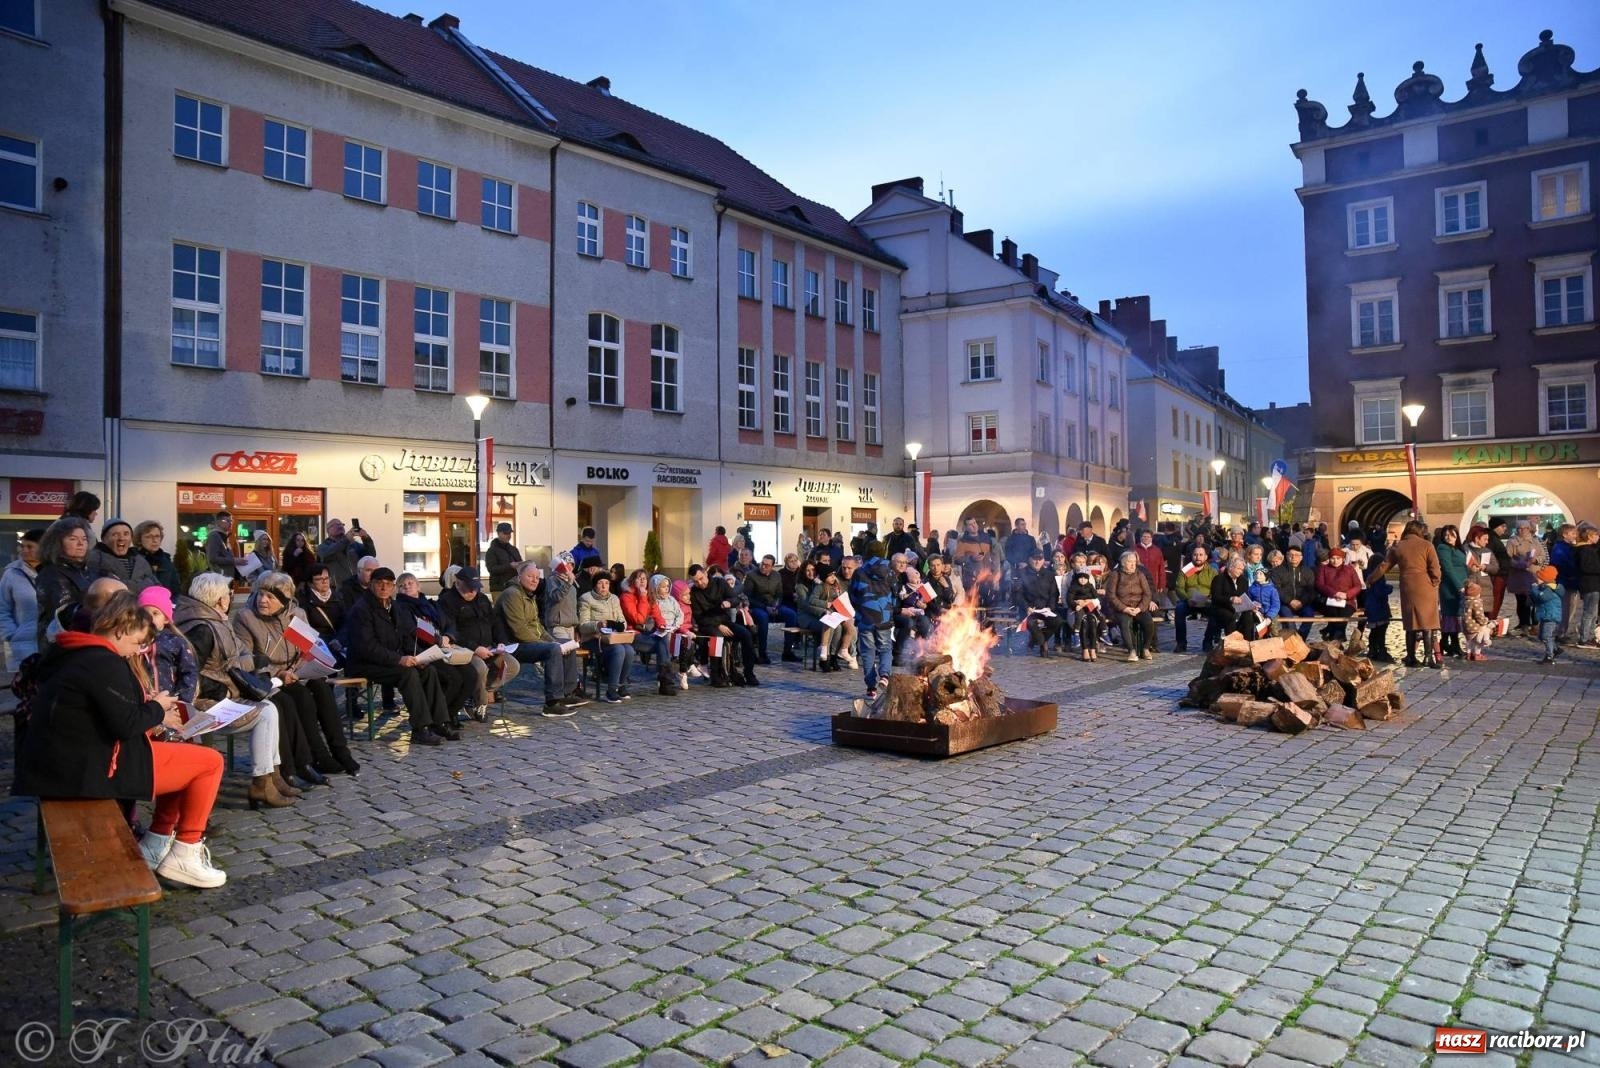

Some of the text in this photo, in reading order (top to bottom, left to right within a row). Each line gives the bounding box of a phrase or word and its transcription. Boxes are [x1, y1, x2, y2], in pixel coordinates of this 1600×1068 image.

[392, 448, 497, 475] JUBILE
[1451, 441, 1581, 466] KANTOR
[586, 466, 630, 481] BOLKO
[657, 474, 698, 485] RACIBORSKA
[794, 477, 841, 494] JUBILER
